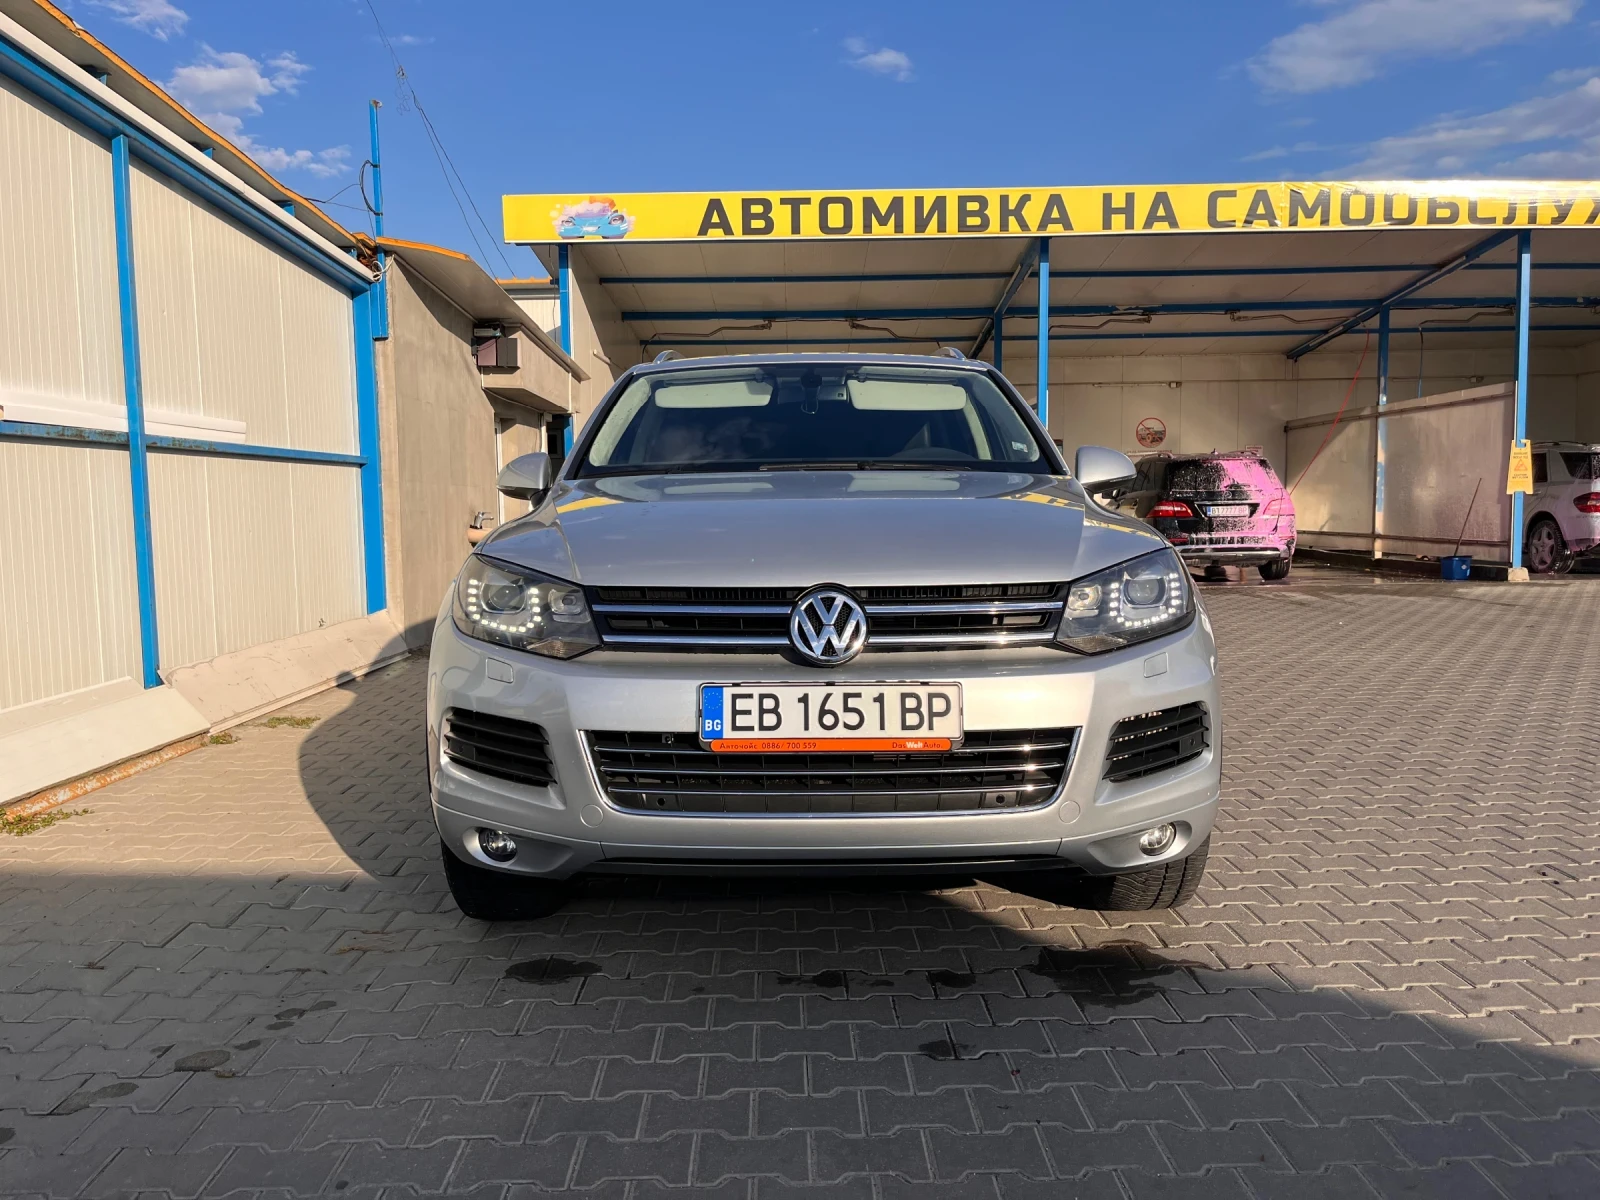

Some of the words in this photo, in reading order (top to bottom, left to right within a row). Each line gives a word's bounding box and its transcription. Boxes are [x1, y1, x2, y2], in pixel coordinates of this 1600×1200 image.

[697, 194, 1075, 236] АВТОМИВКА
[1102, 191, 1179, 230] НА
[793, 590, 865, 660] VW
[704, 719, 722, 731] BG
[731, 692, 783, 732] EB
[797, 692, 887, 731] 1651
[900, 692, 952, 731] BP
[787, 742, 801, 750] 700
[803, 742, 817, 750] 559
